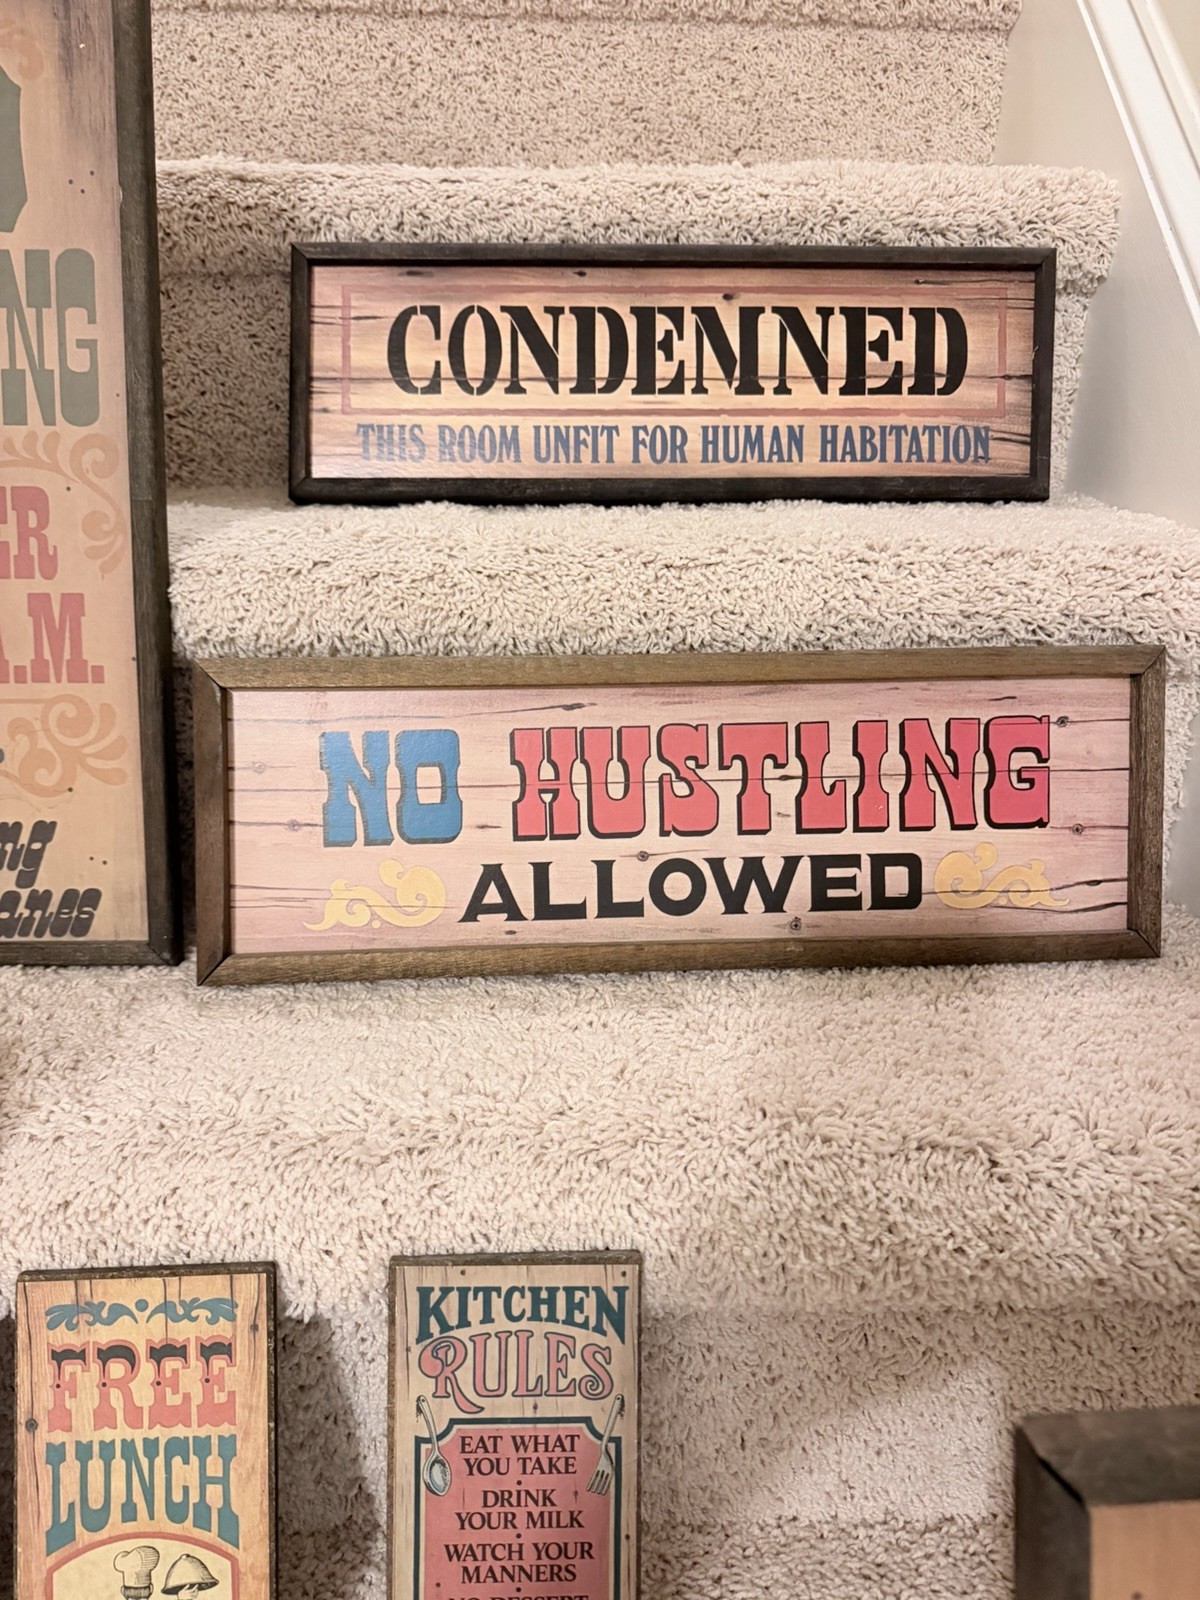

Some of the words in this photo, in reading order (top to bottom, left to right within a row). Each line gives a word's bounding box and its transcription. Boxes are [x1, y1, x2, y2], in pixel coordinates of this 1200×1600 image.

[387, 305, 968, 398] CONDEMNED
[356, 423, 426, 462] THIS
[437, 424, 522, 464] ROOM
[532, 425, 620, 464] UNFIT
[631, 424, 688, 464] FOR
[700, 425, 804, 463] HUMAN
[819, 424, 990, 464] HABITATION
[318, 727, 463, 848] NO
[510, 714, 1051, 842] HUSTLING
[458, 852, 923, 923] ALLOWED
[416, 1285, 630, 1345] KITCHEN
[47, 1334, 237, 1433] FREE
[418, 1329, 614, 1414] RULES
[459, 1436, 502, 1454] EAT
[511, 1434, 580, 1453] WHAT
[463, 1458, 510, 1476] YOU
[517, 1456, 577, 1475] TAKE
[45, 1433, 240, 1557] LUNCH
[455, 1511, 517, 1530] YOUR
[525, 1510, 584, 1529] MILK
[482, 1488, 557, 1508] DRINK
[444, 1543, 524, 1562] WATCH
[531, 1541, 595, 1560] YOUR
[461, 1564, 577, 1584] MANNERS
